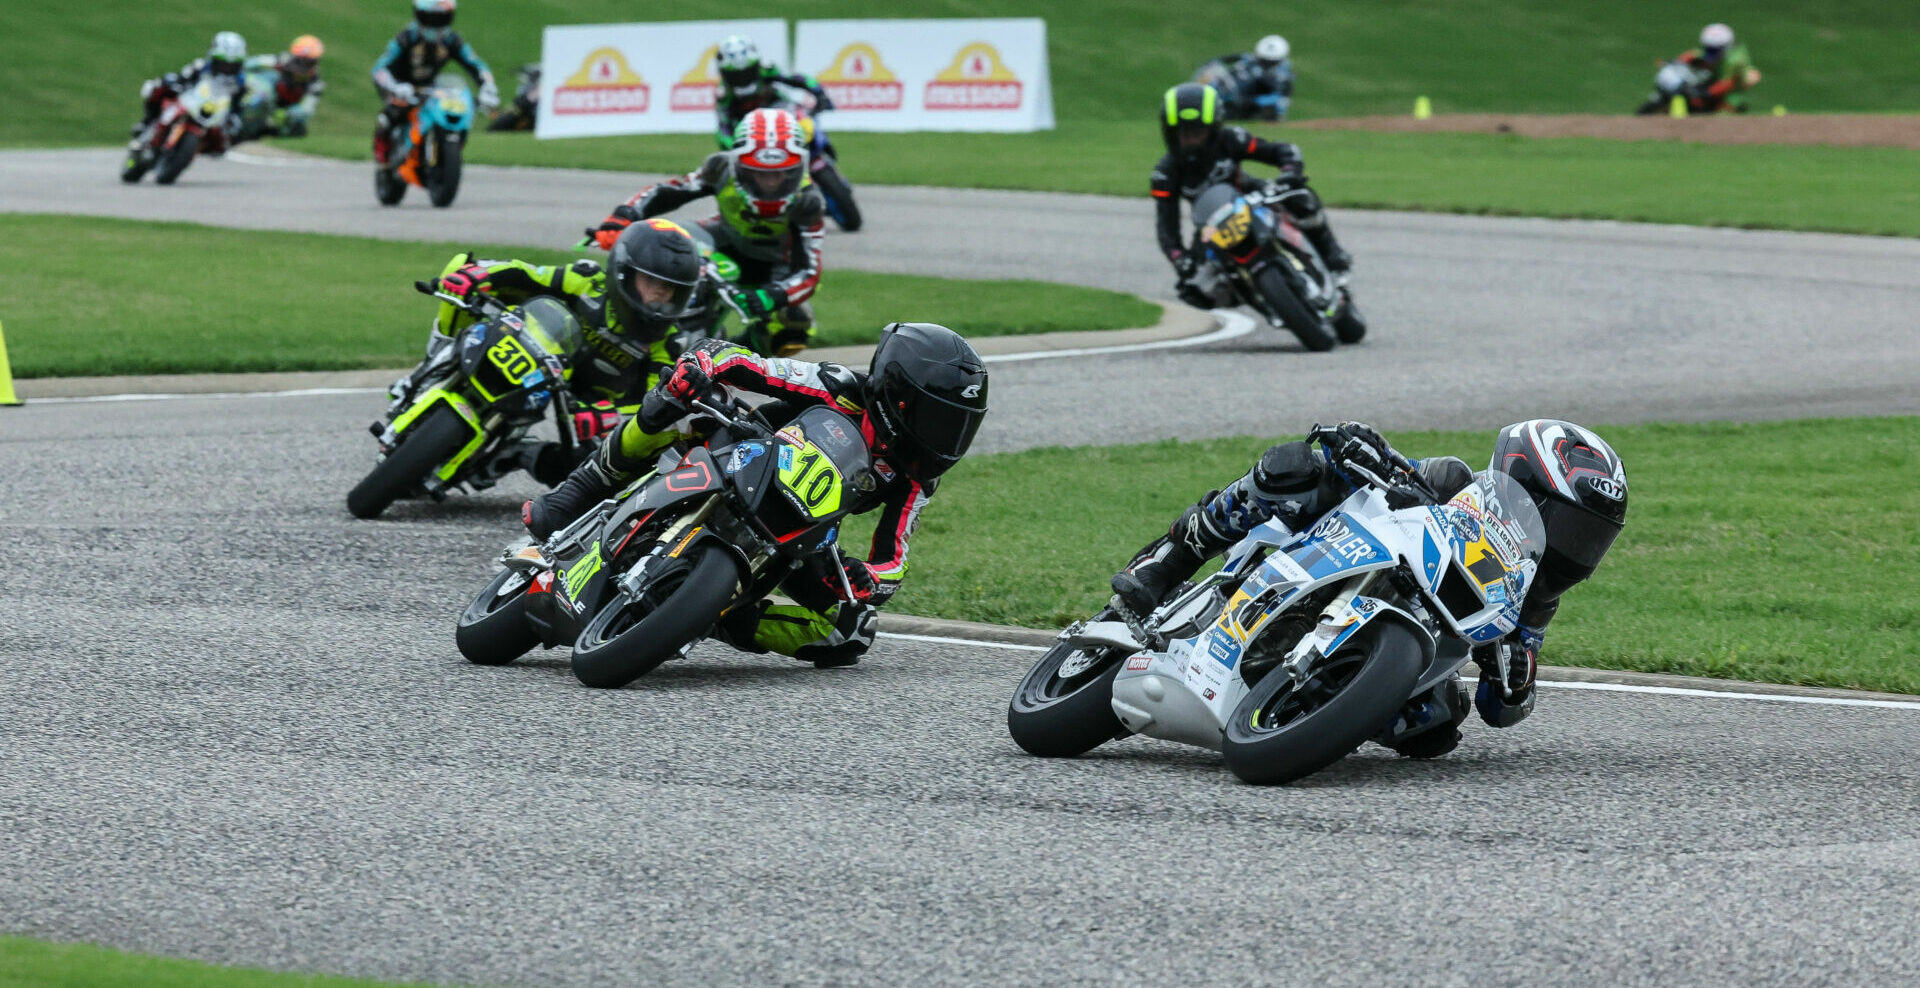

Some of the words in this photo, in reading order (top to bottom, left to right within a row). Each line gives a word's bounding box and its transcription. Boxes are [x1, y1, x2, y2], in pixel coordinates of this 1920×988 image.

[491, 338, 533, 382] 30
[791, 452, 834, 508] 10
[1590, 477, 1623, 498] KYT
[1468, 549, 1506, 585] 1
